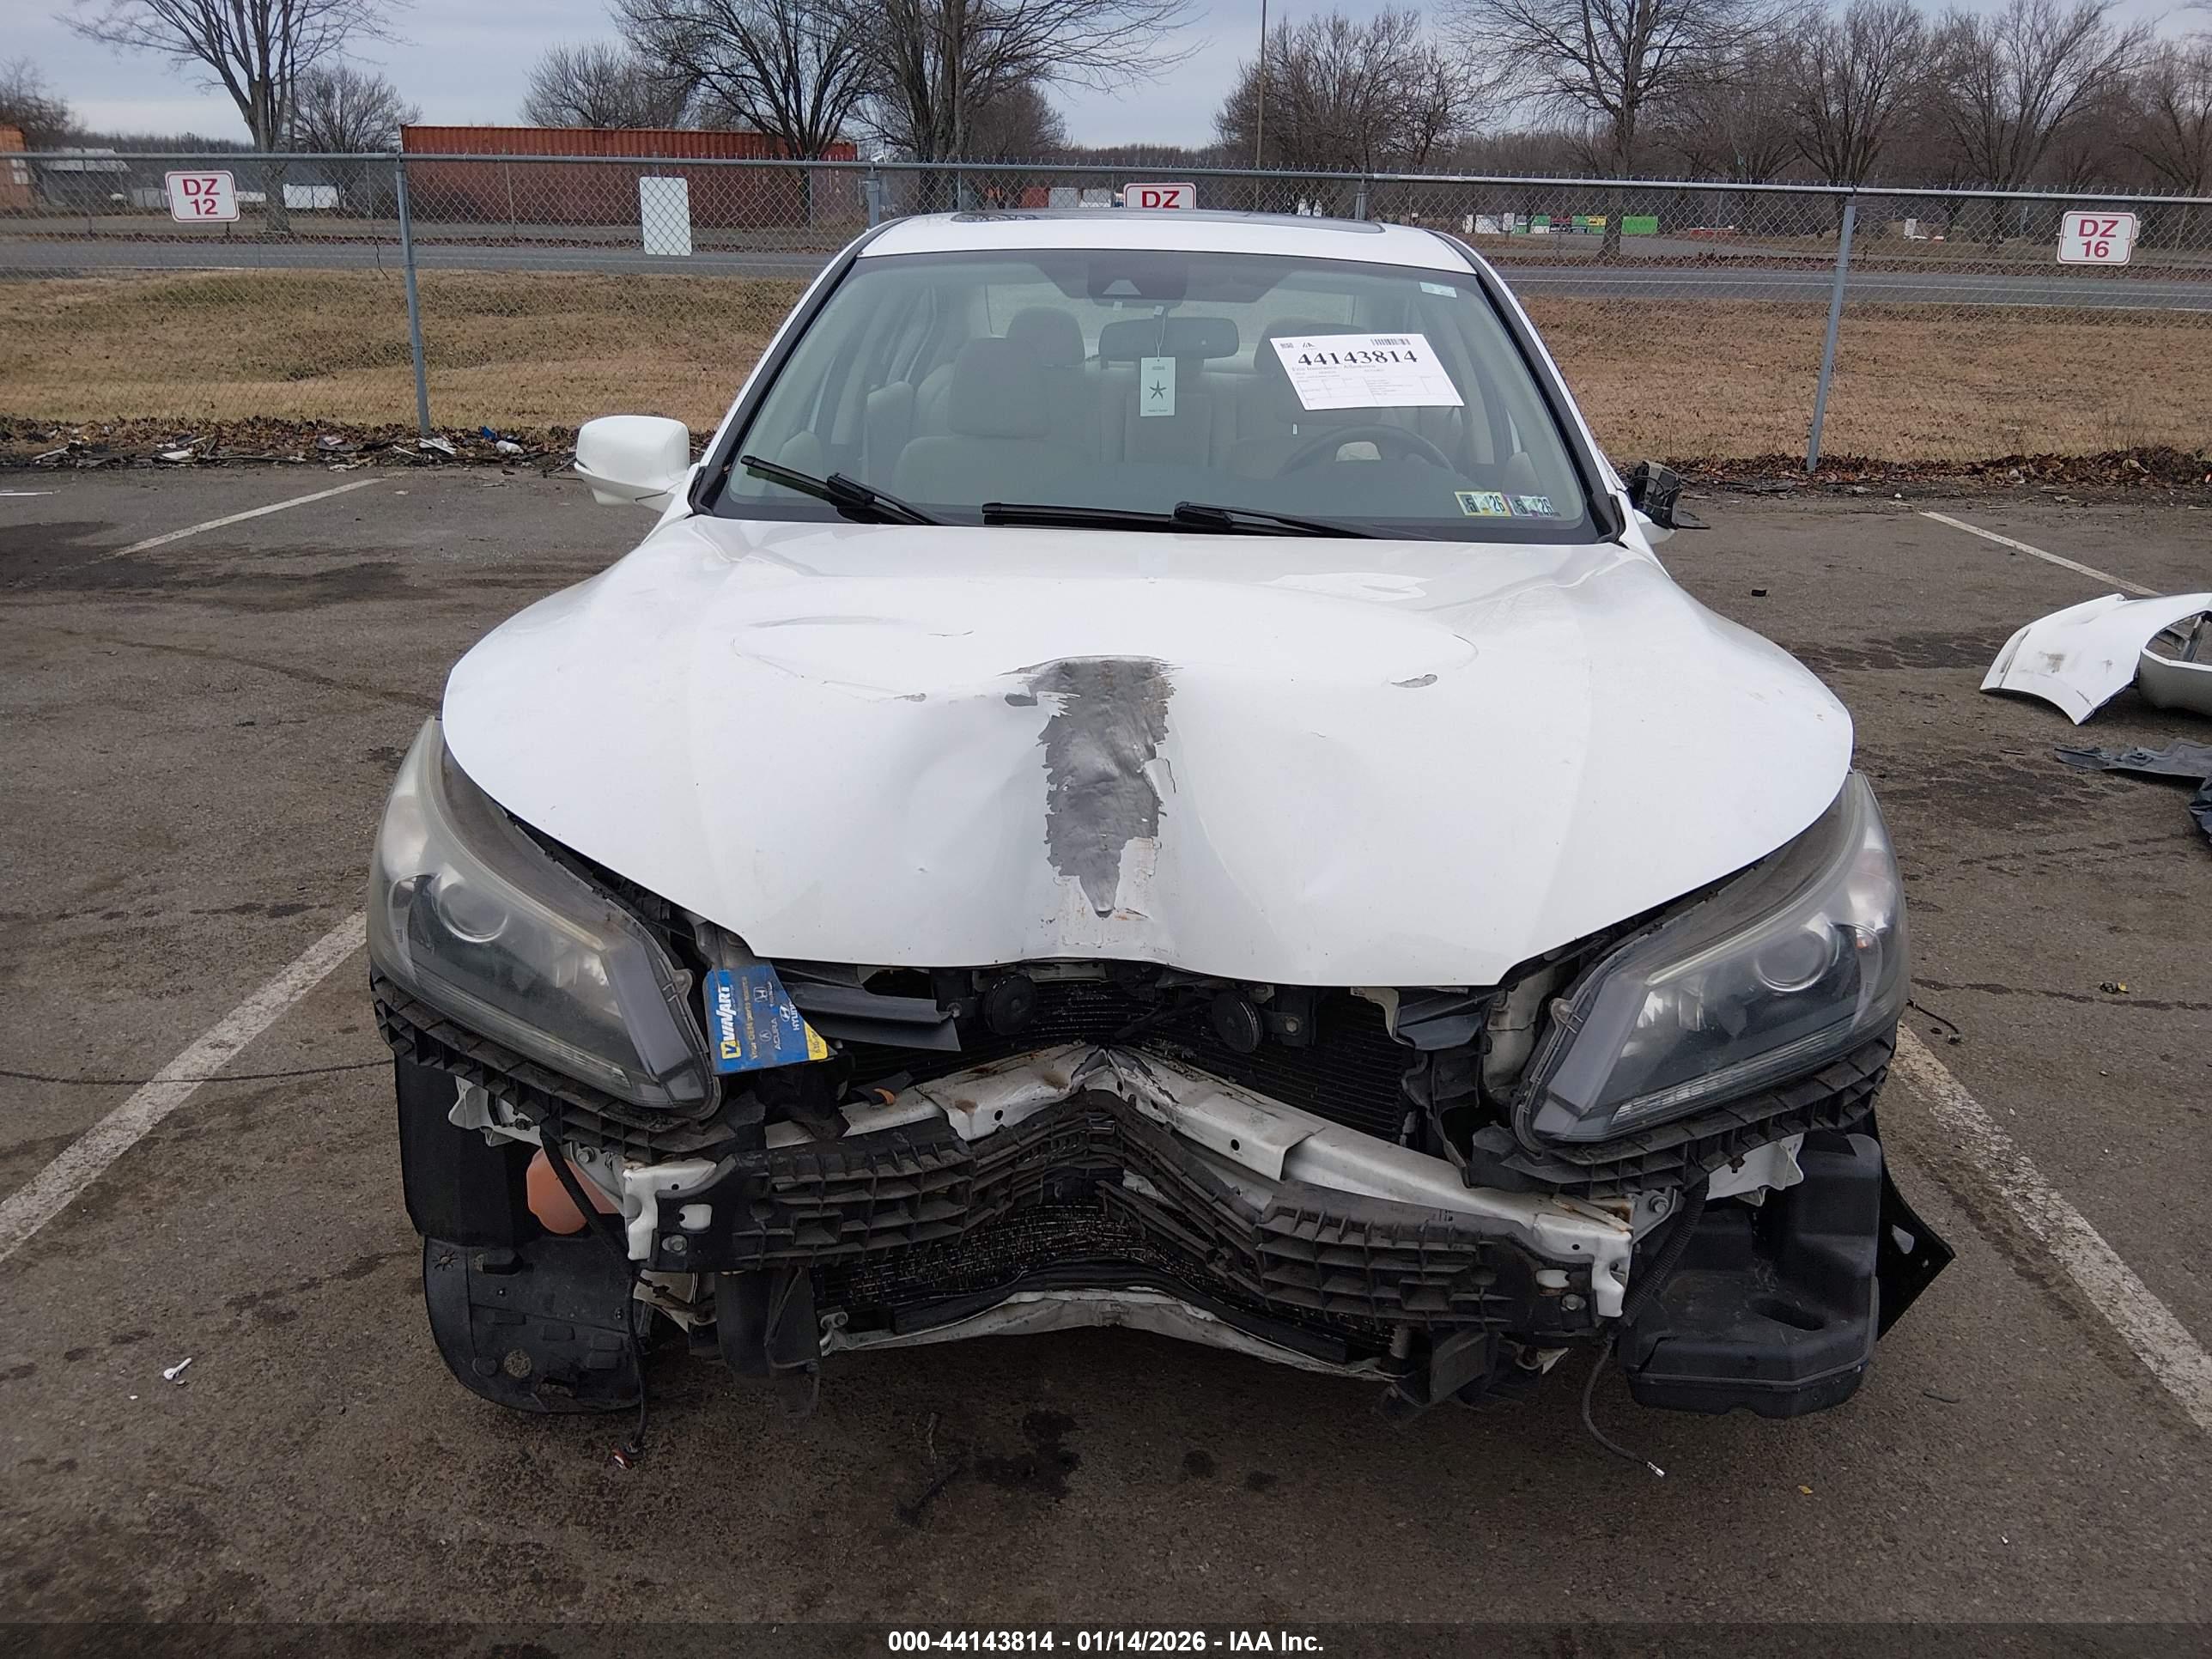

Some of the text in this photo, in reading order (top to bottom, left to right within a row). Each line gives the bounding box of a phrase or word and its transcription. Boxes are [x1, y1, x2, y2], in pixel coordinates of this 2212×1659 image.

[182, 179, 220, 196] DZ
[190, 198, 218, 216] 12
[1142, 191, 1180, 209] DZ
[2079, 219, 2118, 238] DZ
[2081, 240, 2109, 258] 16
[1297, 349, 1418, 366] 44143814
[1489, 495, 1505, 512] 26
[788, 998, 799, 1031] HYUN
[771, 1018, 781, 1050] ACURA
